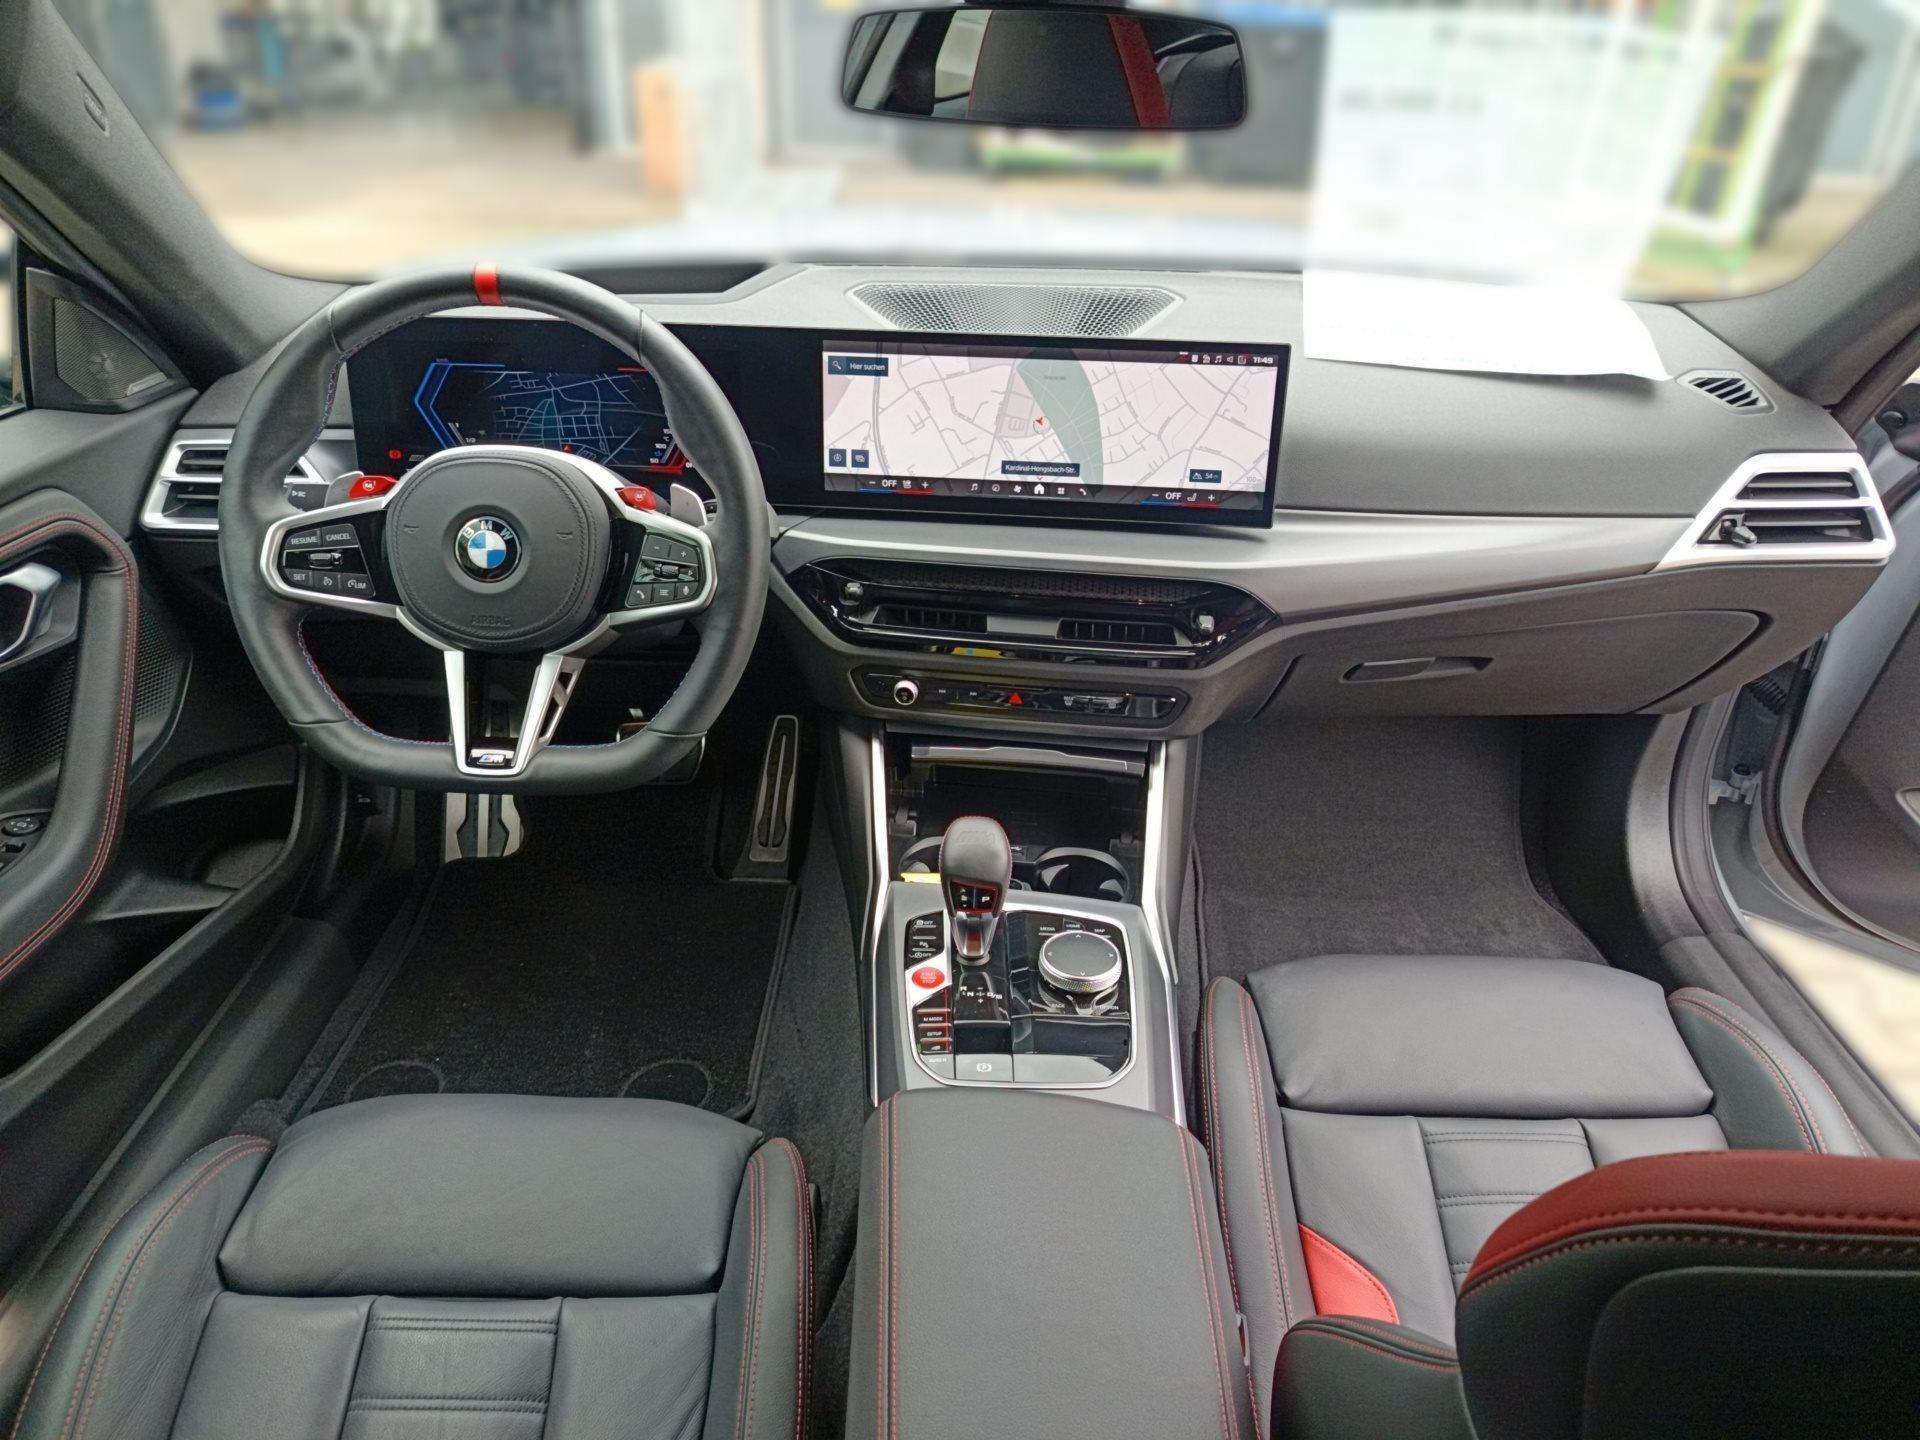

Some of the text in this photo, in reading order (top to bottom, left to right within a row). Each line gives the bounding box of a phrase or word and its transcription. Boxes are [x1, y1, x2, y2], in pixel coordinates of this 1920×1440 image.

[1252, 356, 1274, 364] 11:49
[849, 362, 886, 371] Hier suchen
[881, 479, 898, 488] OFF
[1165, 491, 1182, 500] OFF
[463, 519, 514, 541] BMW
[291, 536, 318, 545] RESUME
[326, 532, 351, 541] CANCEL
